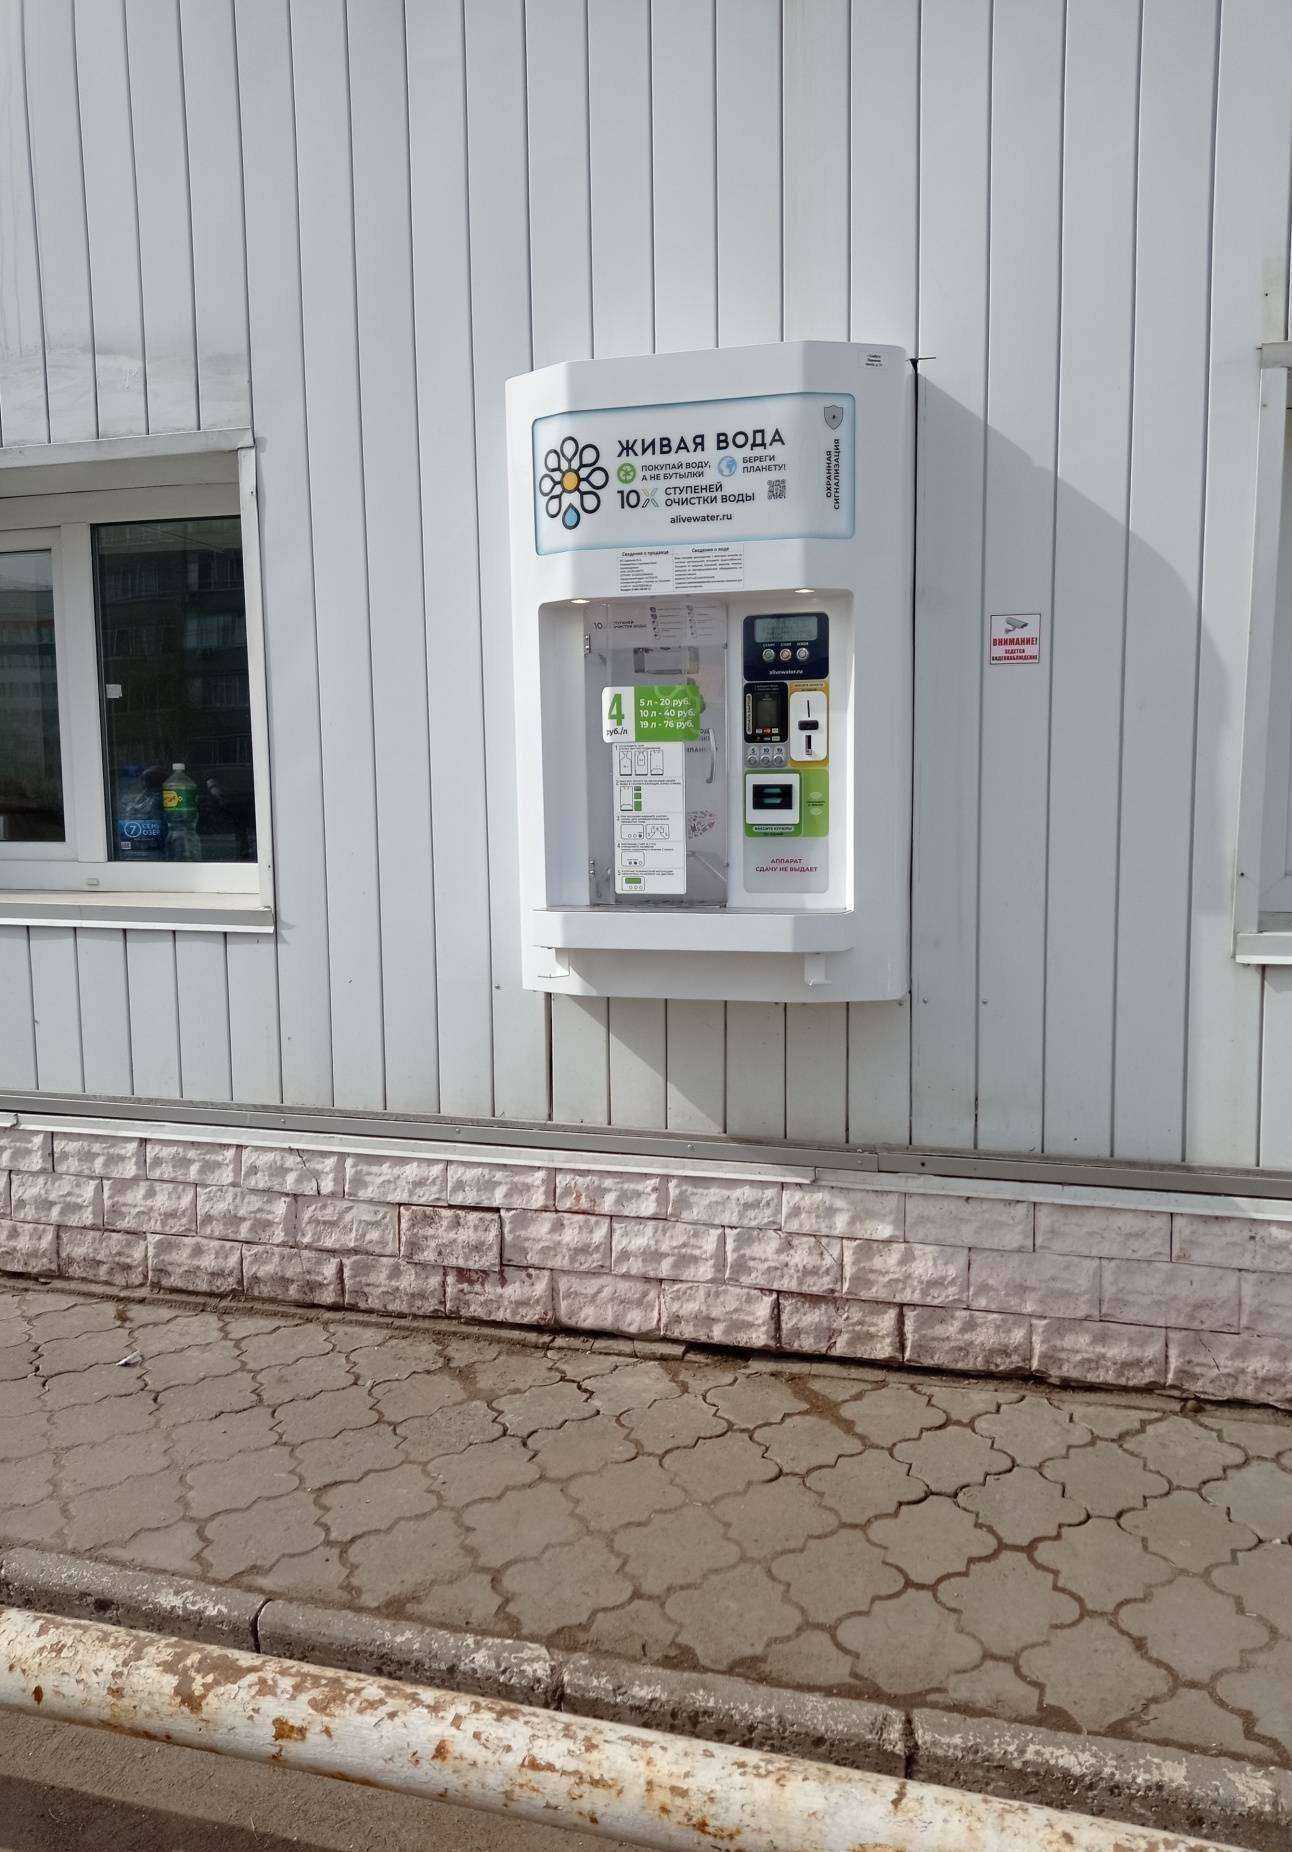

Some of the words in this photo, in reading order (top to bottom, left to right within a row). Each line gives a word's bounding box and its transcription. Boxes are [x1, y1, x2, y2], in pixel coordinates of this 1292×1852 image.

[617, 434, 705, 457] ЖИВАЯ
[716, 428, 785, 451] ВОДА
[742, 454, 775, 464] БЕРЕГИ
[641, 461, 683, 472] ПОКУПАЙ
[685, 460, 711, 470] ВОДУ,
[742, 463, 786, 473] ПЛАНЕТУ!
[650, 473, 661, 481] НЕ
[663, 470, 704, 480] БУТЫЛКИ
[665, 481, 723, 496] СТУПЕНЕЙ
[665, 494, 717, 507] ОЧИСТКИ
[721, 492, 755, 504] ВОДЫ
[670, 511, 732, 524] alivewater.ru
[992, 637, 1038, 647] ВНИМАНИЕ!
[639, 698, 645, 706] 5
[660, 698, 671, 706] 20
[608, 693, 625, 726] 4
[639, 709, 649, 718] 10
[664, 709, 675, 717] 40
[677, 708, 696, 718] руб.
[639, 720, 649, 729] 19
[663, 720, 674, 728] 76
[676, 719, 695, 730] руб.
